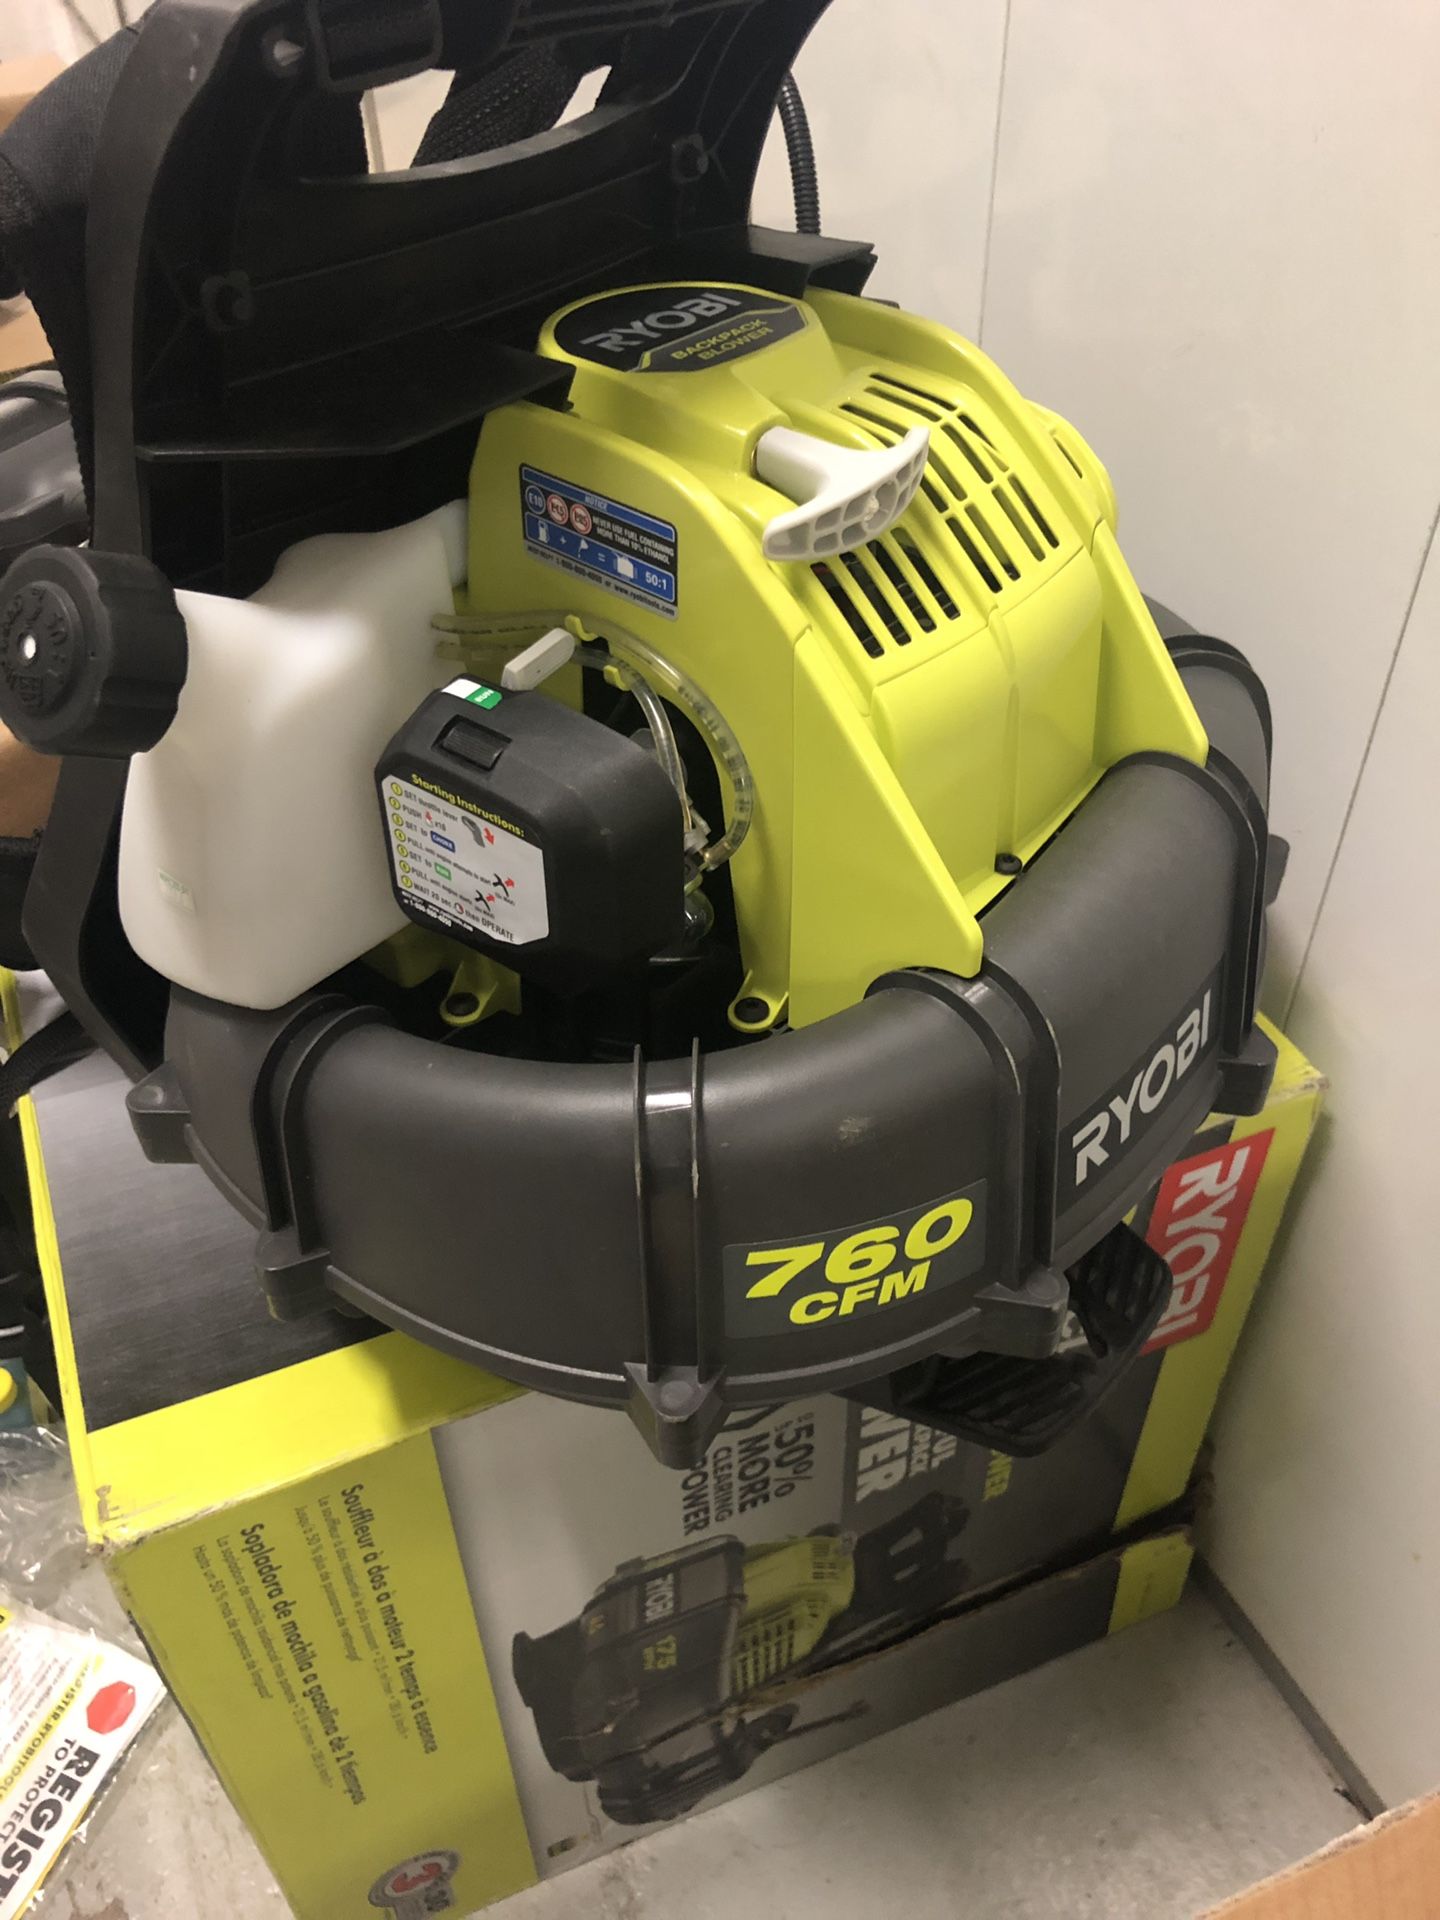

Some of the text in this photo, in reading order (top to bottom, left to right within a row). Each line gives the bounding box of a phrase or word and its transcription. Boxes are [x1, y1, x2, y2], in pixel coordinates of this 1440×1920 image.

[579, 292, 742, 353] RYOBI
[670, 318, 768, 360] BACKPACK
[698, 327, 774, 361] BLOWER
[592, 515, 675, 557] NEVER USE FUEL CONTAINING
[597, 526, 614, 540] MORE
[614, 533, 630, 547] THAN
[644, 546, 670, 565] ETHANOL
[645, 570, 667, 590] 50:1
[402, 803, 422, 819] PUSH
[411, 772, 525, 838] Starting Instructions:
[407, 836, 424, 851] PULL
[411, 866, 429, 881] PULL
[413, 881, 430, 896] WAIT
[481, 917, 514, 942] OPERATE
[1071, 990, 1211, 1187] RYOBI
[744, 1197, 973, 1300] 760
[1149, 1145, 1251, 1341] RYOBI
[788, 1260, 930, 1325] CFM
[737, 1432, 771, 1514] MORE
[774, 1422, 815, 1498] 50%
[712, 1446, 734, 1523] CLEARING
[342, 1484, 374, 1548] Souffleur
[306, 1533, 321, 1546] 50
[363, 1552, 383, 1564] à
[241, 1524, 283, 1599] Sopladora
[367, 1565, 388, 1591] dos
[209, 1580, 225, 1593] 50
[376, 1592, 391, 1603] à
[273, 1600, 296, 1619] de
[381, 1605, 405, 1649] moteur
[282, 1621, 316, 1672] mochila
[395, 1650, 414, 1662] 2
[302, 1673, 316, 1684] a
[400, 1662, 421, 1700] temps
[303, 1685, 338, 1735] gasolina
[54, 1738, 77, 1761] TO
[329, 1736, 348, 1753] de
[414, 1712, 437, 1754] essence
[336, 1751, 354, 1763] 2
[0, 1765, 56, 1845] PROTECT
[0, 1745, 101, 1900] REGIST
